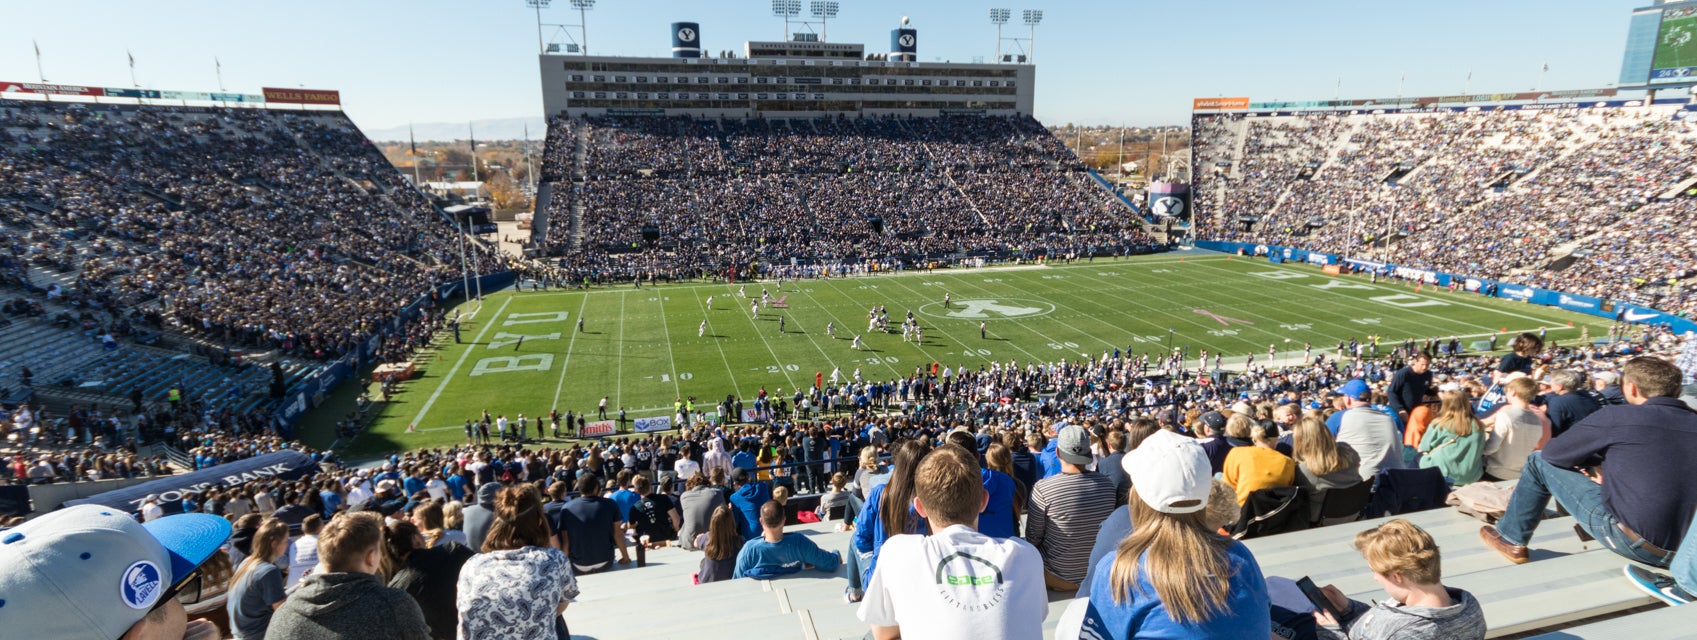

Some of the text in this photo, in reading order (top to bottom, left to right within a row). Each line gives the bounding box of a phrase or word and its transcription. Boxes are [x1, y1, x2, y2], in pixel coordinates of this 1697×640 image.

[266, 91, 301, 100] WELLS
[304, 93, 338, 102] FARGO
[1160, 199, 1181, 214] Y
[1247, 270, 1452, 308] BYU
[469, 311, 569, 377] BYU
[1047, 341, 1080, 350] 50
[963, 348, 992, 357] 40
[866, 355, 900, 365] 30
[766, 363, 800, 374] 20
[661, 372, 694, 383] 10
[649, 418, 669, 427] BOX
[223, 461, 295, 488] BANK
[136, 580, 159, 604] LAVELL
